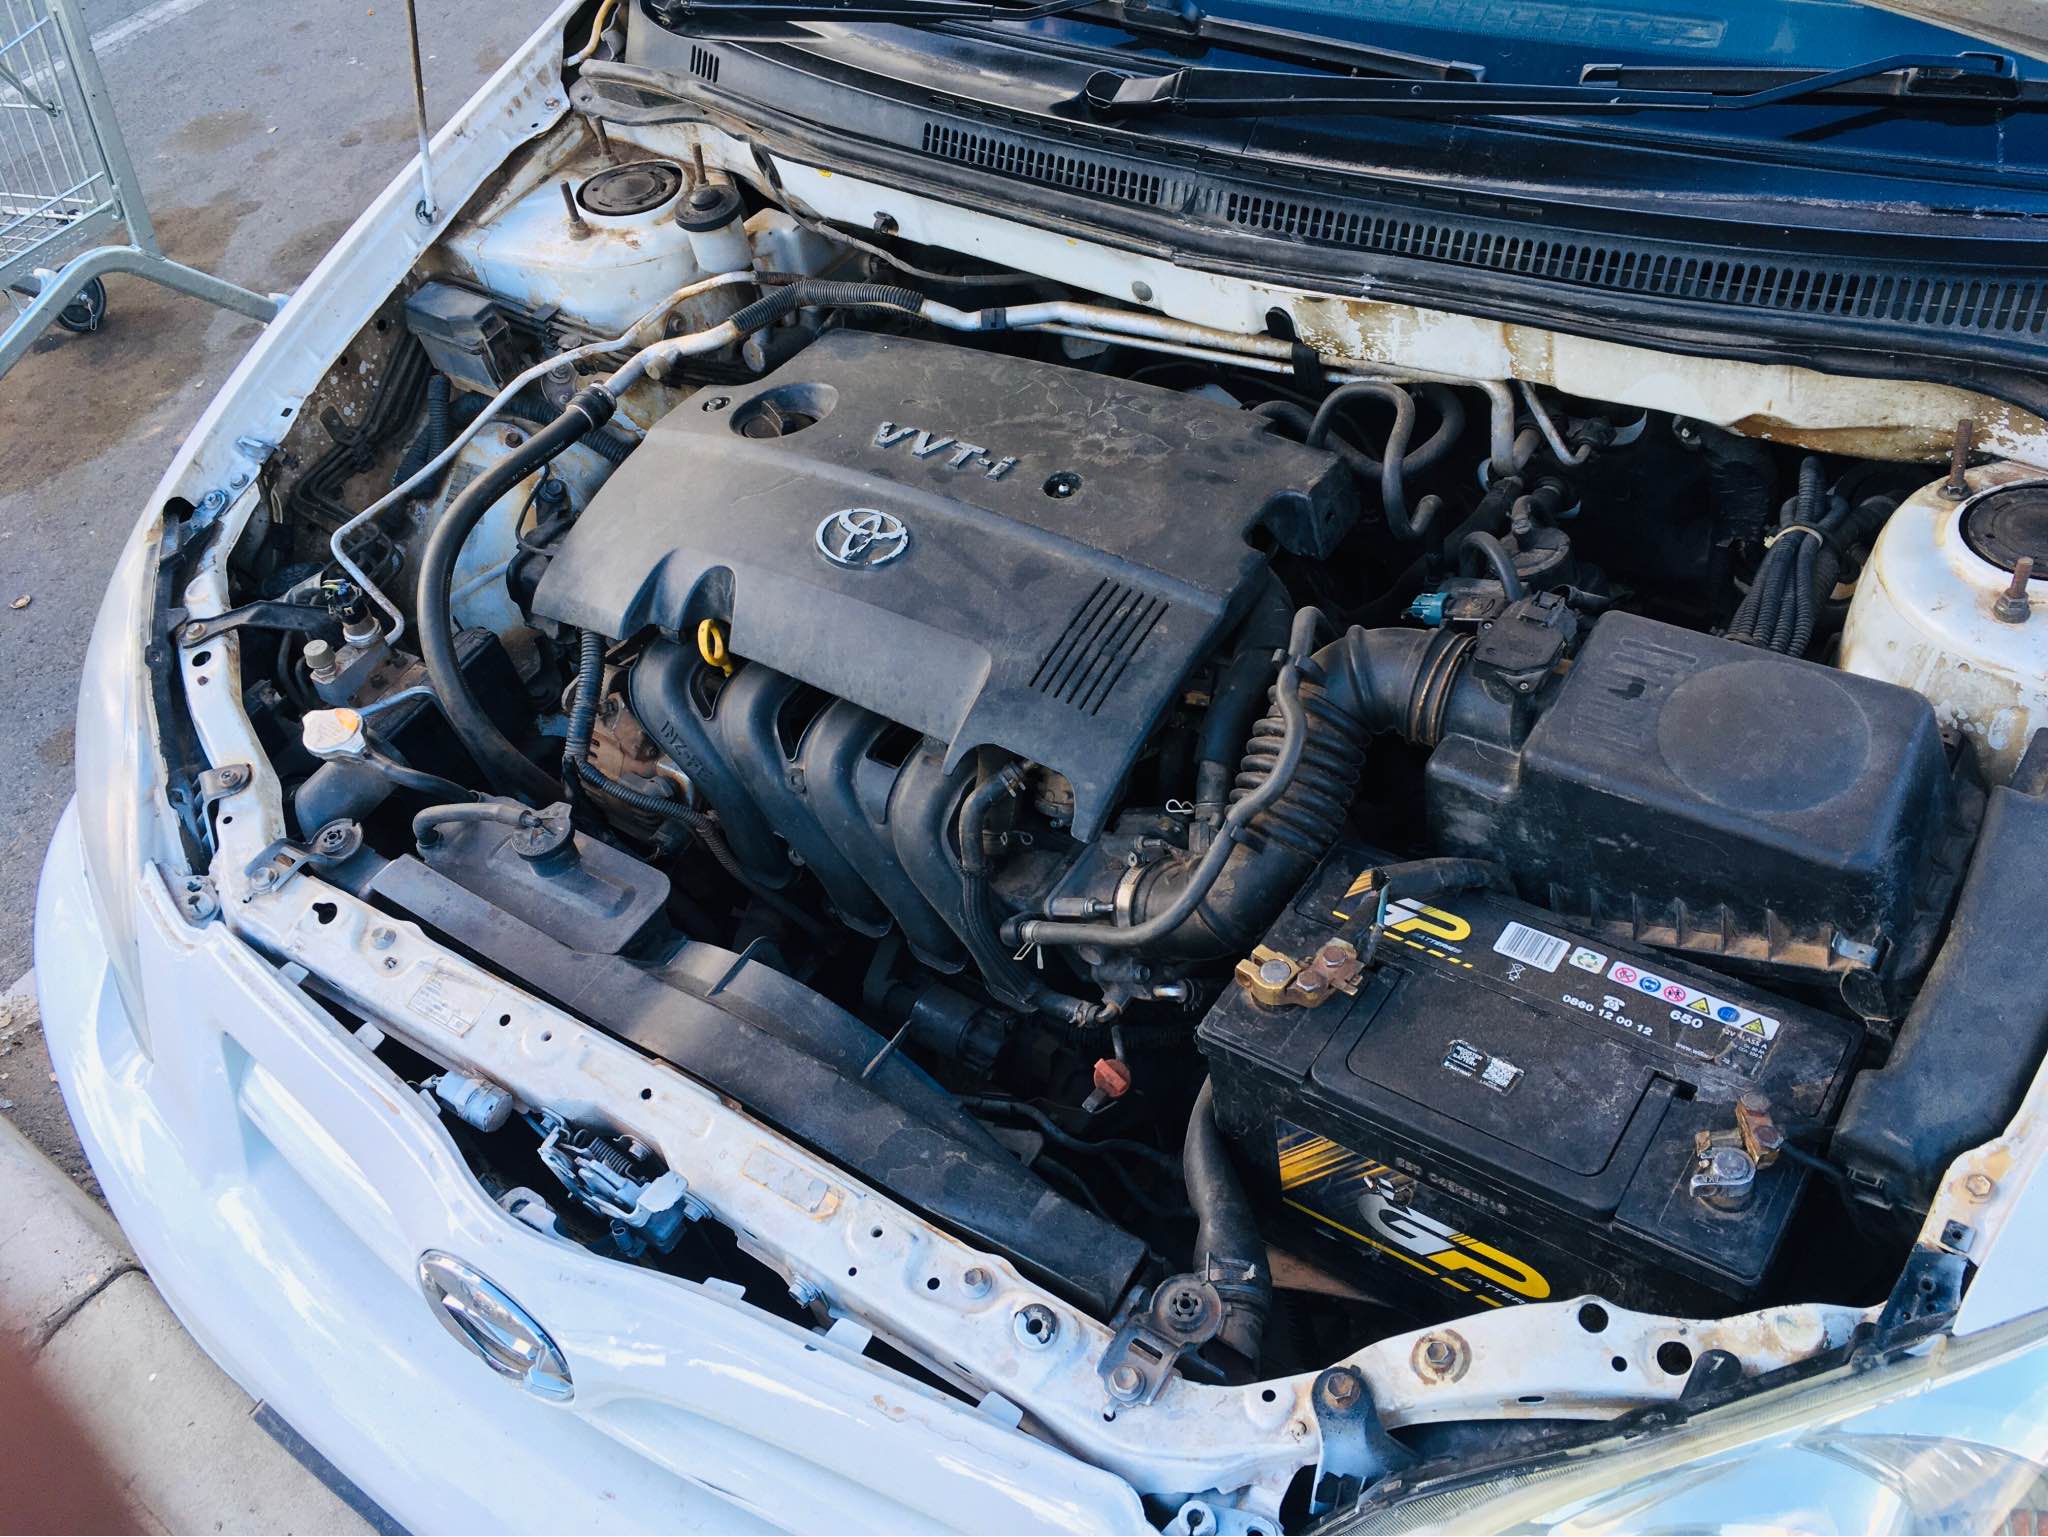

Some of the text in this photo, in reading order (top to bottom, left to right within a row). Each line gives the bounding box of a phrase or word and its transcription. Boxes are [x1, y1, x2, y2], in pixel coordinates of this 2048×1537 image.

[1562, 994, 1653, 1037] 0860 12 00 12
[1669, 1009, 1704, 1029] 650
